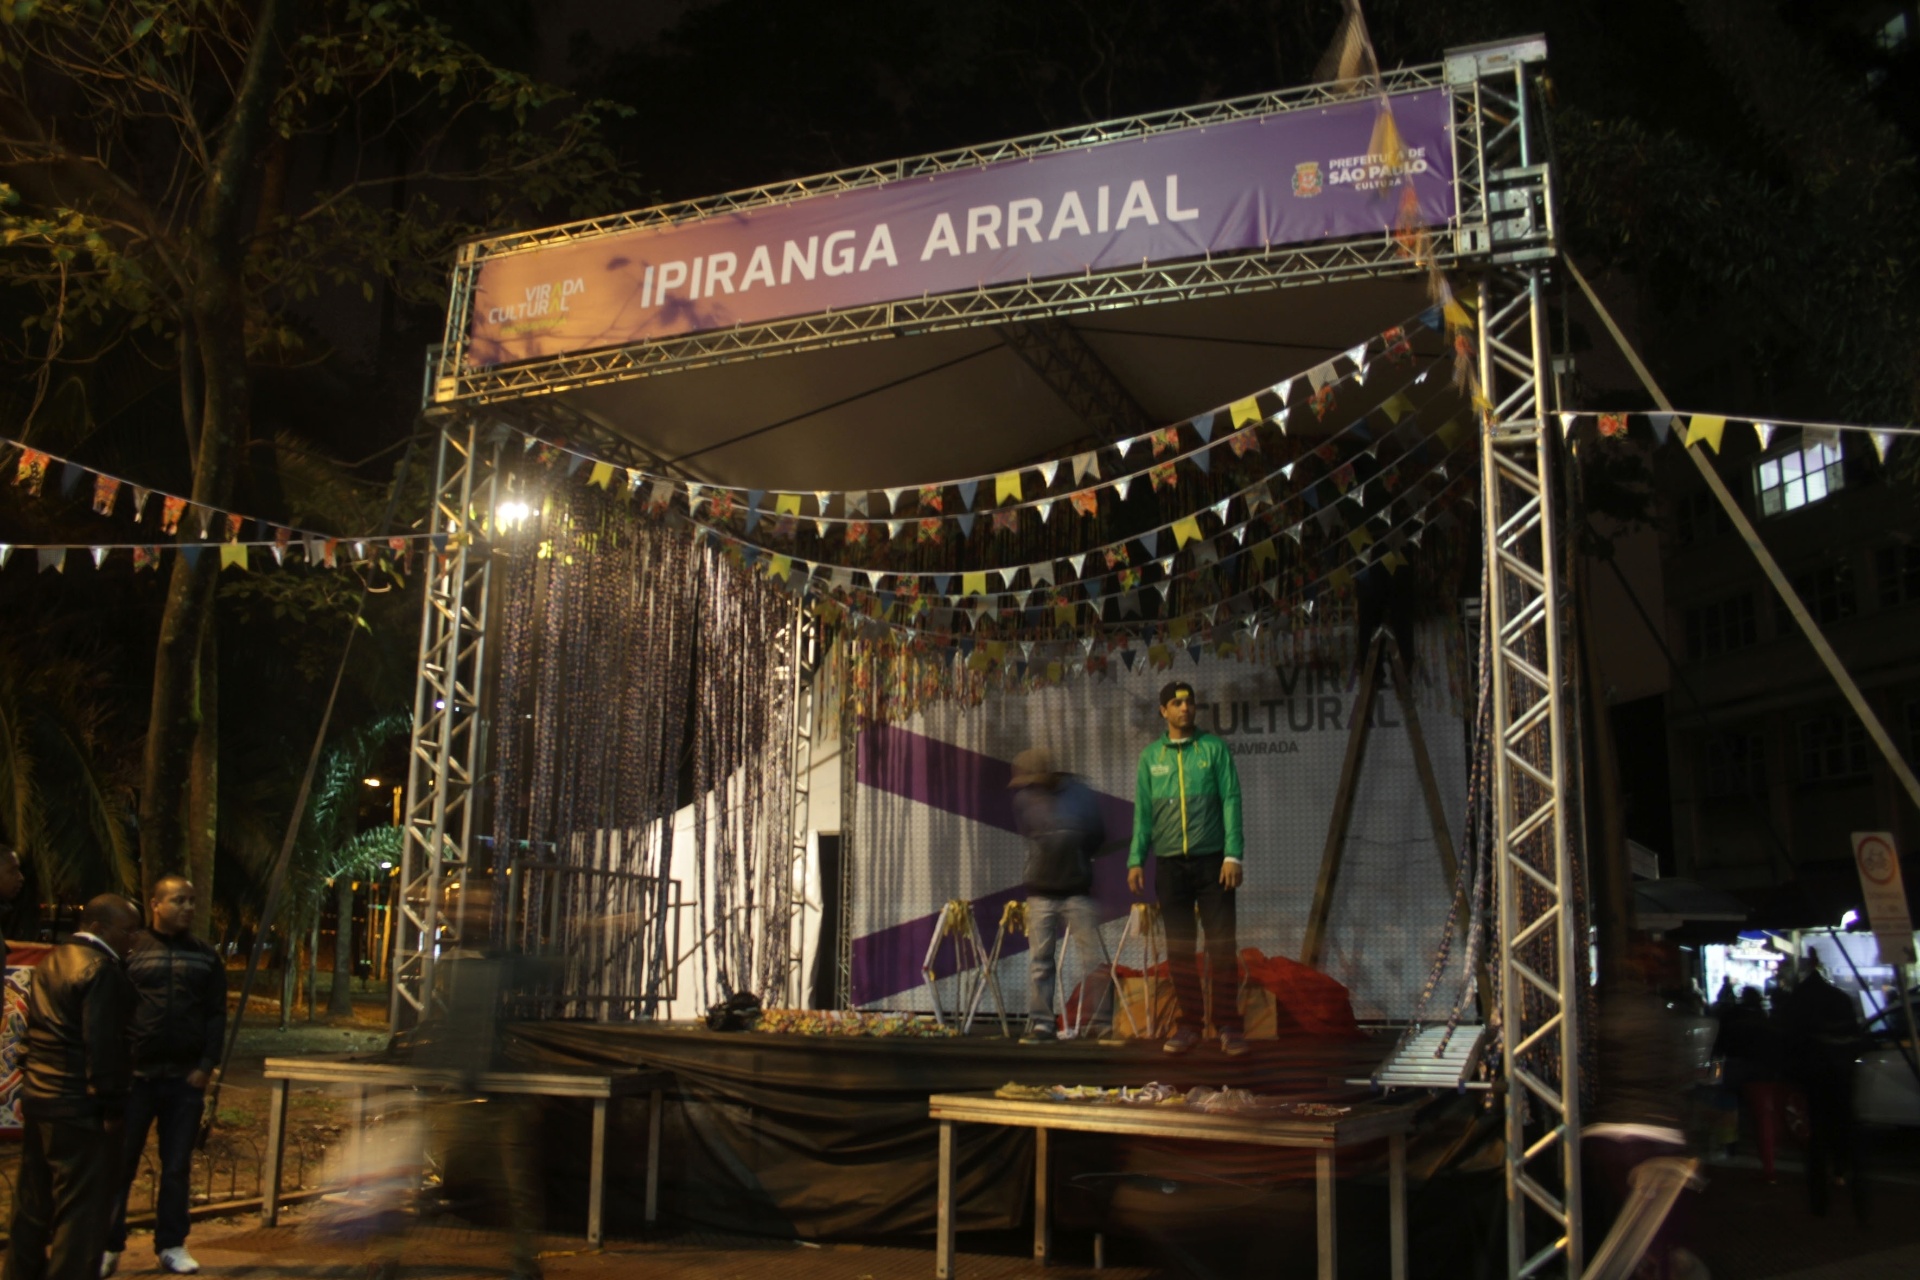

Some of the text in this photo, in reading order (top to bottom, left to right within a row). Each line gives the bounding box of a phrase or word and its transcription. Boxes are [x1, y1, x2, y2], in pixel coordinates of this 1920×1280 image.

[1329, 147, 1426, 169] PREFEITUA DE
[1329, 167, 1366, 185] SÃO
[641, 174, 1199, 308] IPIRANGA ARRAIAL
[525, 277, 585, 302] VIRADA
[488, 296, 570, 325] CULTURAL
